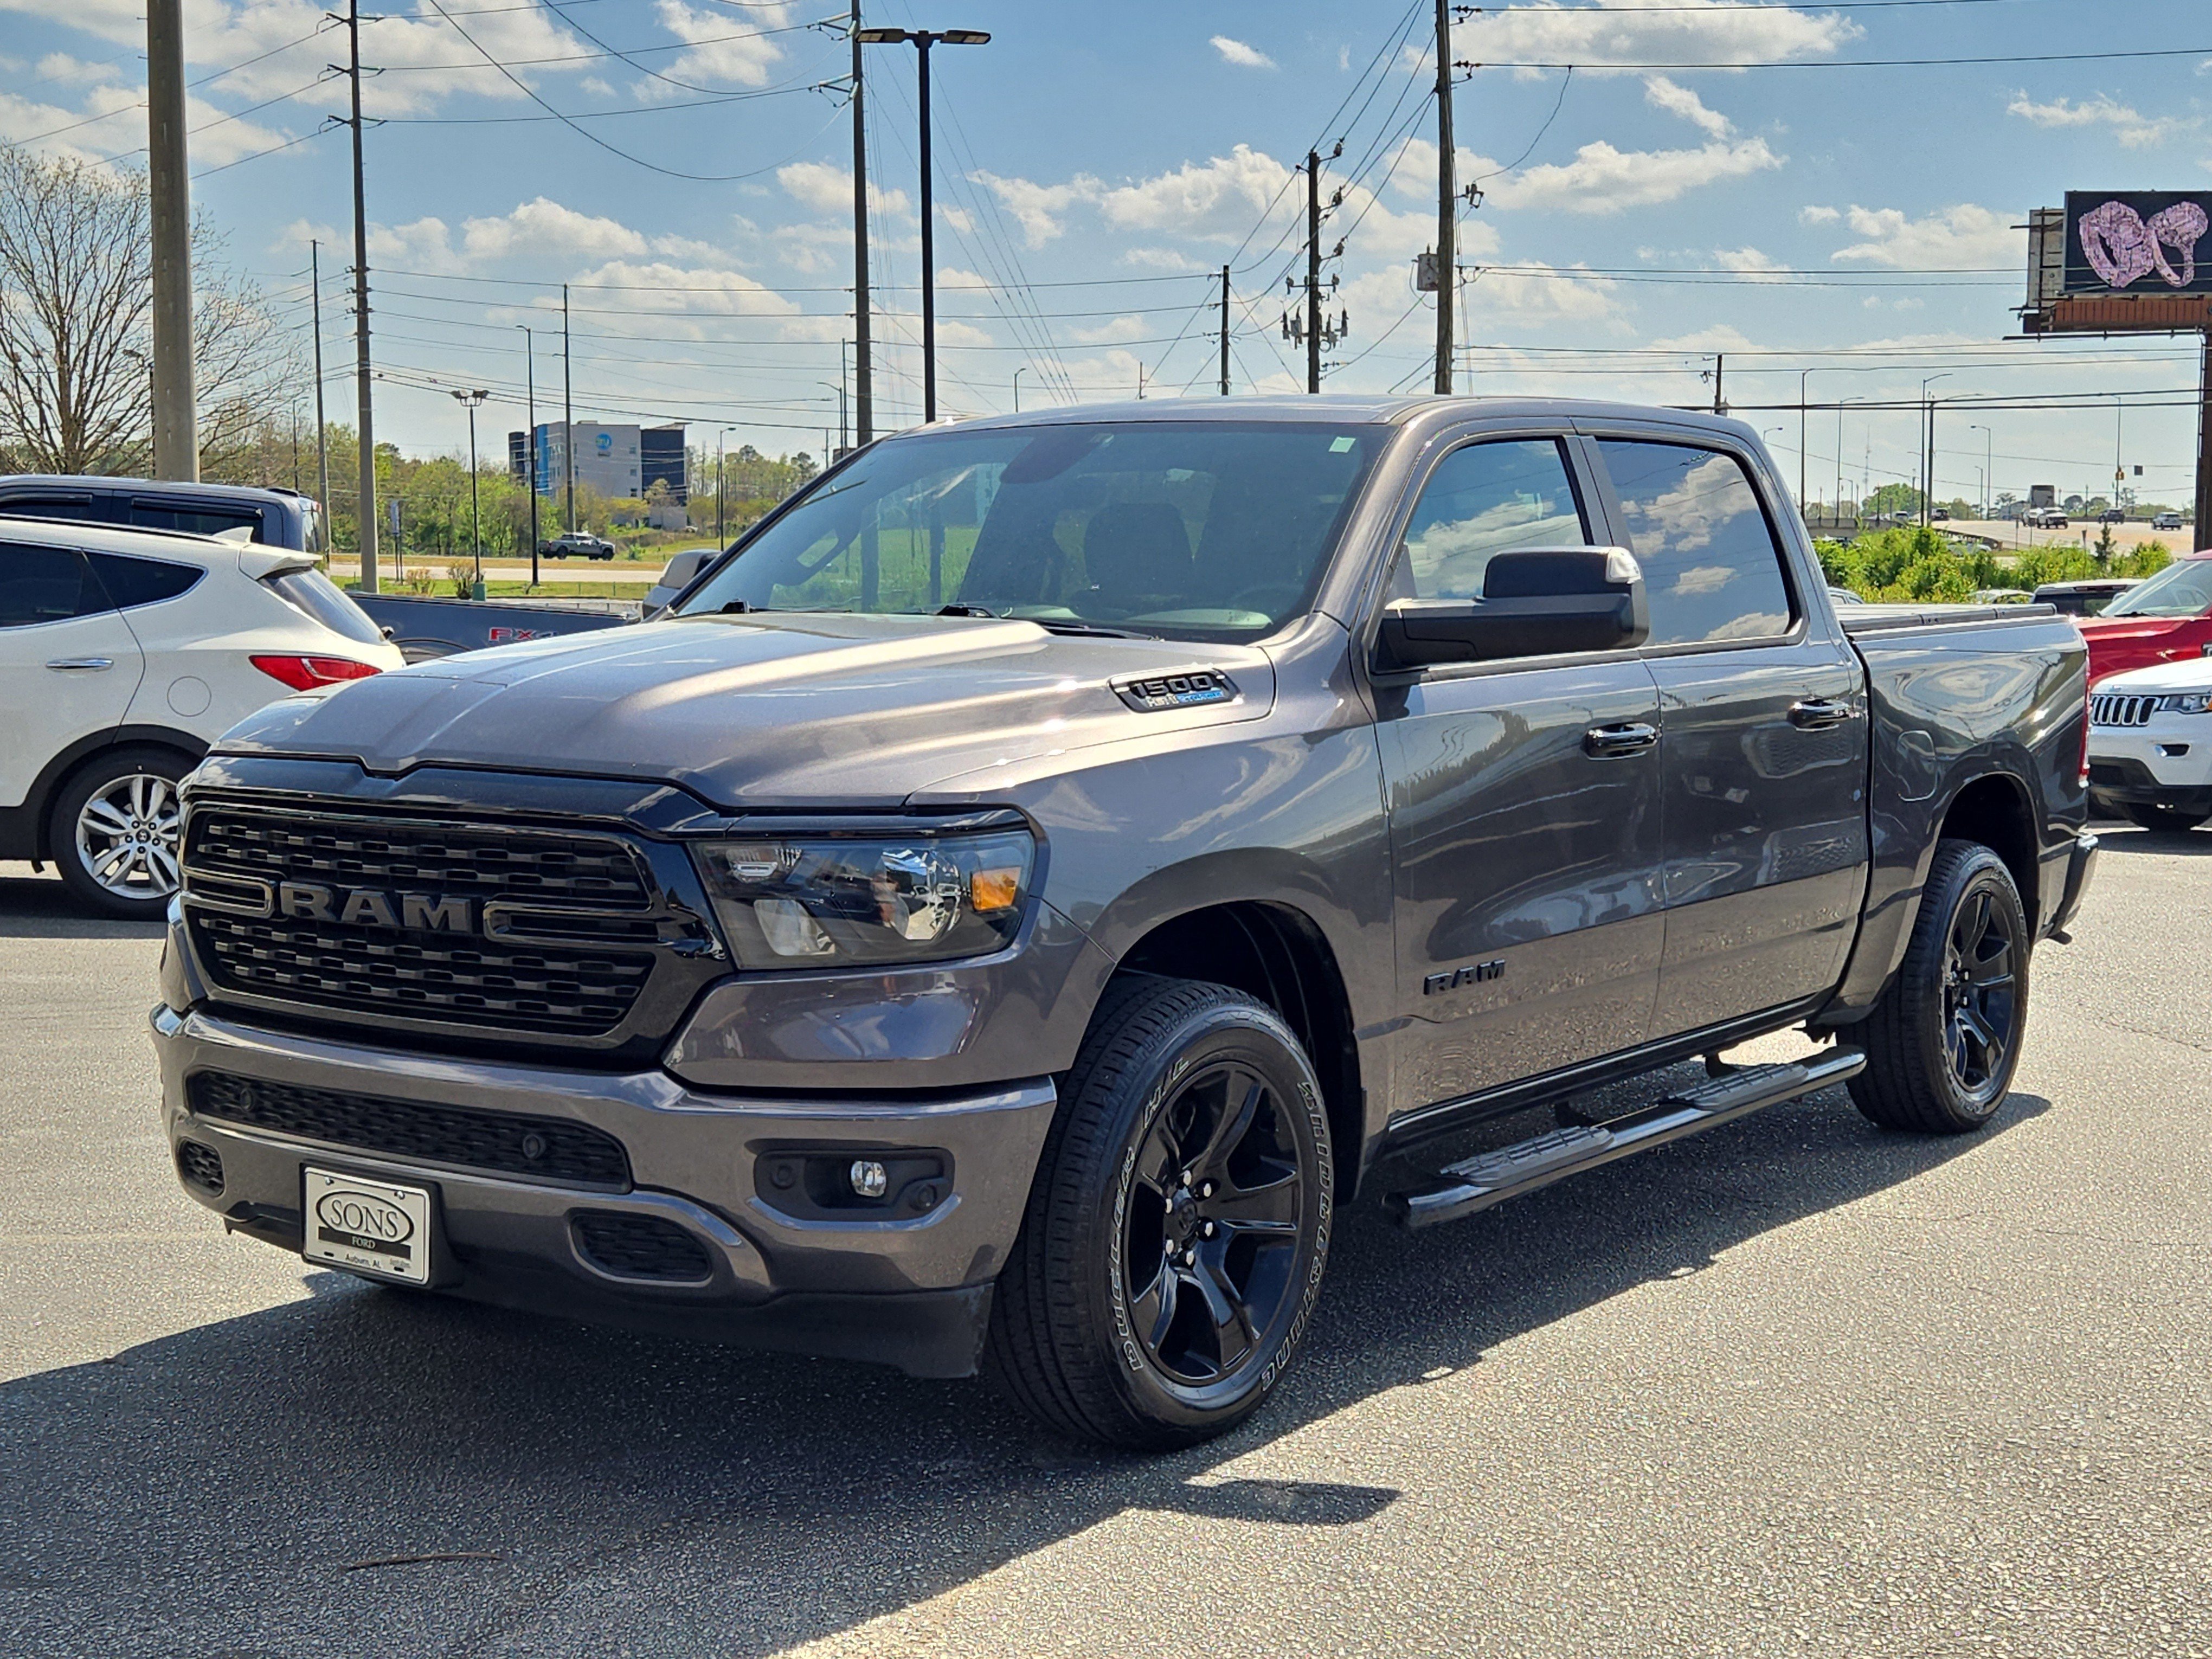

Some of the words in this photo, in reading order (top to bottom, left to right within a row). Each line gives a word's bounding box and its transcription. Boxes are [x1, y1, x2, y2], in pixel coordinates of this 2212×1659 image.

[1132, 674, 1213, 697] 1500
[280, 880, 473, 933] RAM
[1423, 959, 1505, 995] RAM
[330, 1199, 398, 1238] SONS
[351, 1236, 376, 1249] FORD
